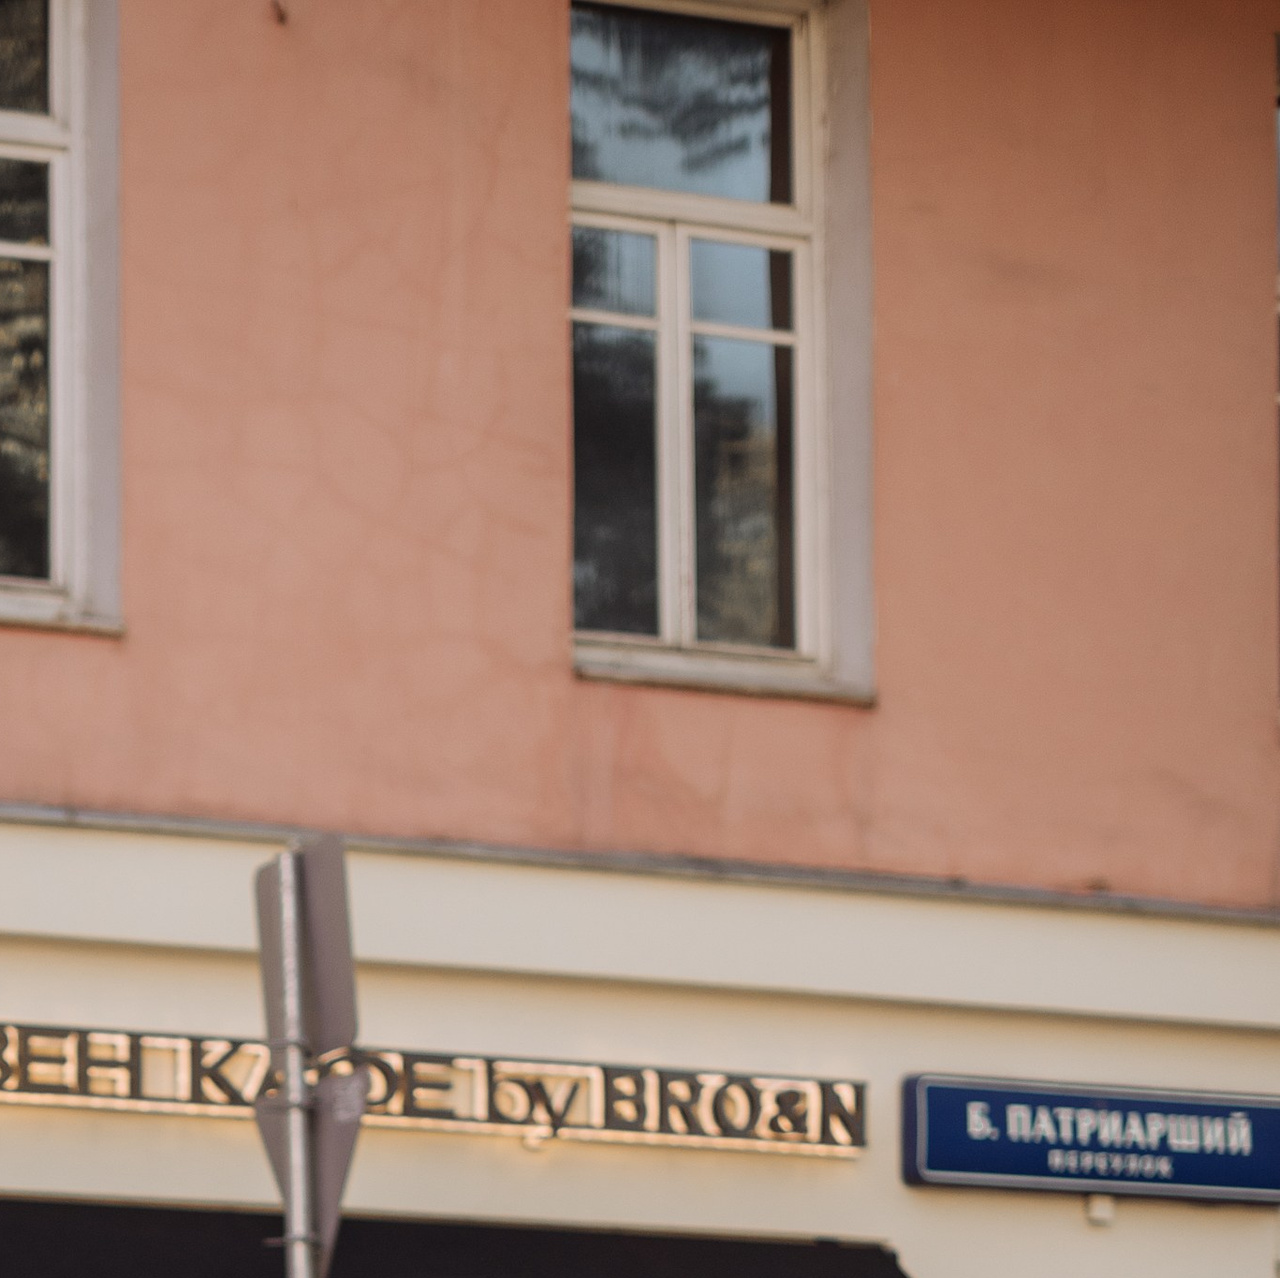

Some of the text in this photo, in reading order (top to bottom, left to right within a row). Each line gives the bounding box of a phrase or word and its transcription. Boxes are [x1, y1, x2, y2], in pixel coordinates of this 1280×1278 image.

[485, 1055, 585, 1142] by
[967, 1101, 1253, 1156] Б. ПАТРИАРШИЙ
